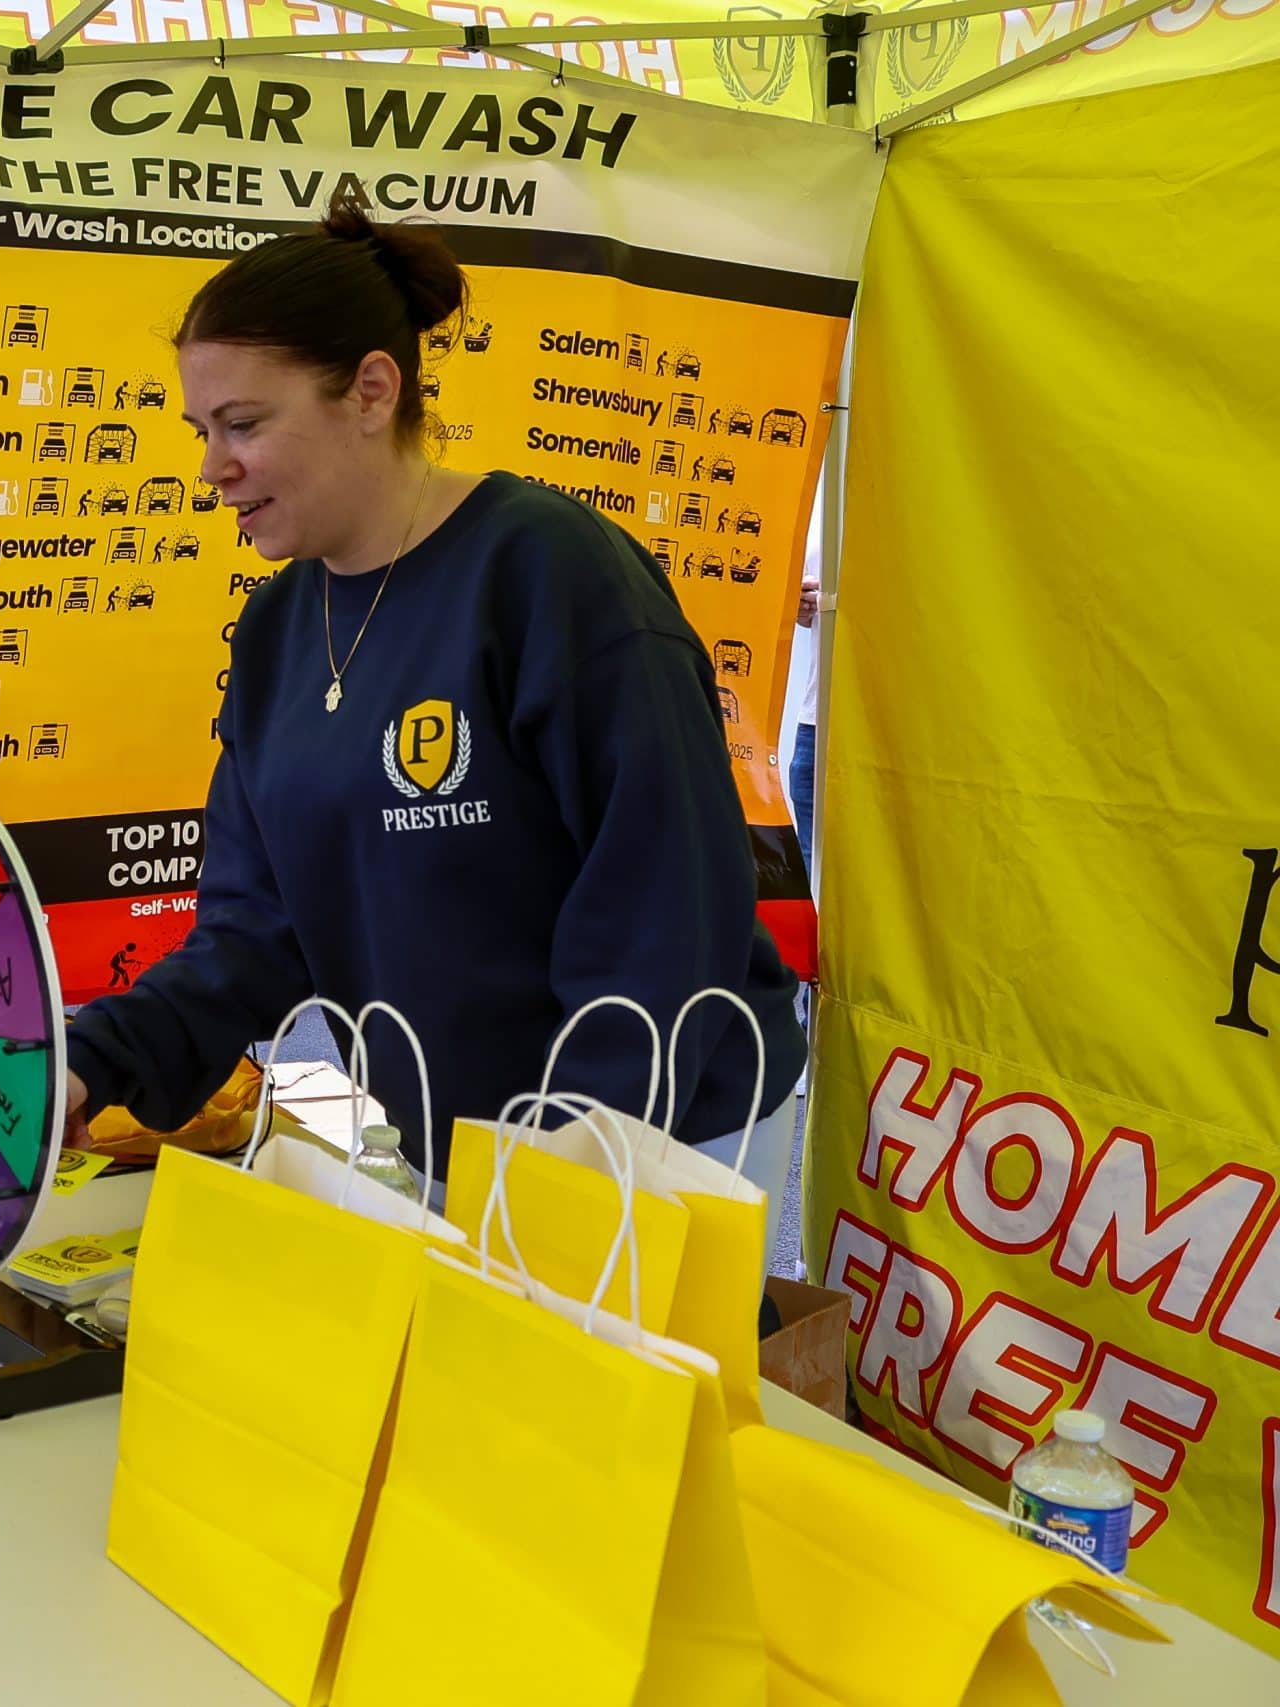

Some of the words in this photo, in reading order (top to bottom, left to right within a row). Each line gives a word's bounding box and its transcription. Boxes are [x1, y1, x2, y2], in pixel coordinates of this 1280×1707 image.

[89, 76, 312, 144] CAR
[345, 86, 638, 169] WASH
[132, 158, 264, 206] FREE
[278, 169, 538, 217] VACUUM
[12, 211, 129, 244] Wash
[136, 218, 279, 252] Location
[539, 328, 620, 361] Salem
[533, 378, 662, 426] Shrewsbury
[437, 425, 474, 440] 2025
[527, 426, 641, 466] Somerville
[407, 716, 445, 764] P
[728, 743, 753, 761] 2025
[382, 800, 491, 831] PRESTIGE
[107, 824, 164, 852] TOP
[171, 820, 199, 846] 10
